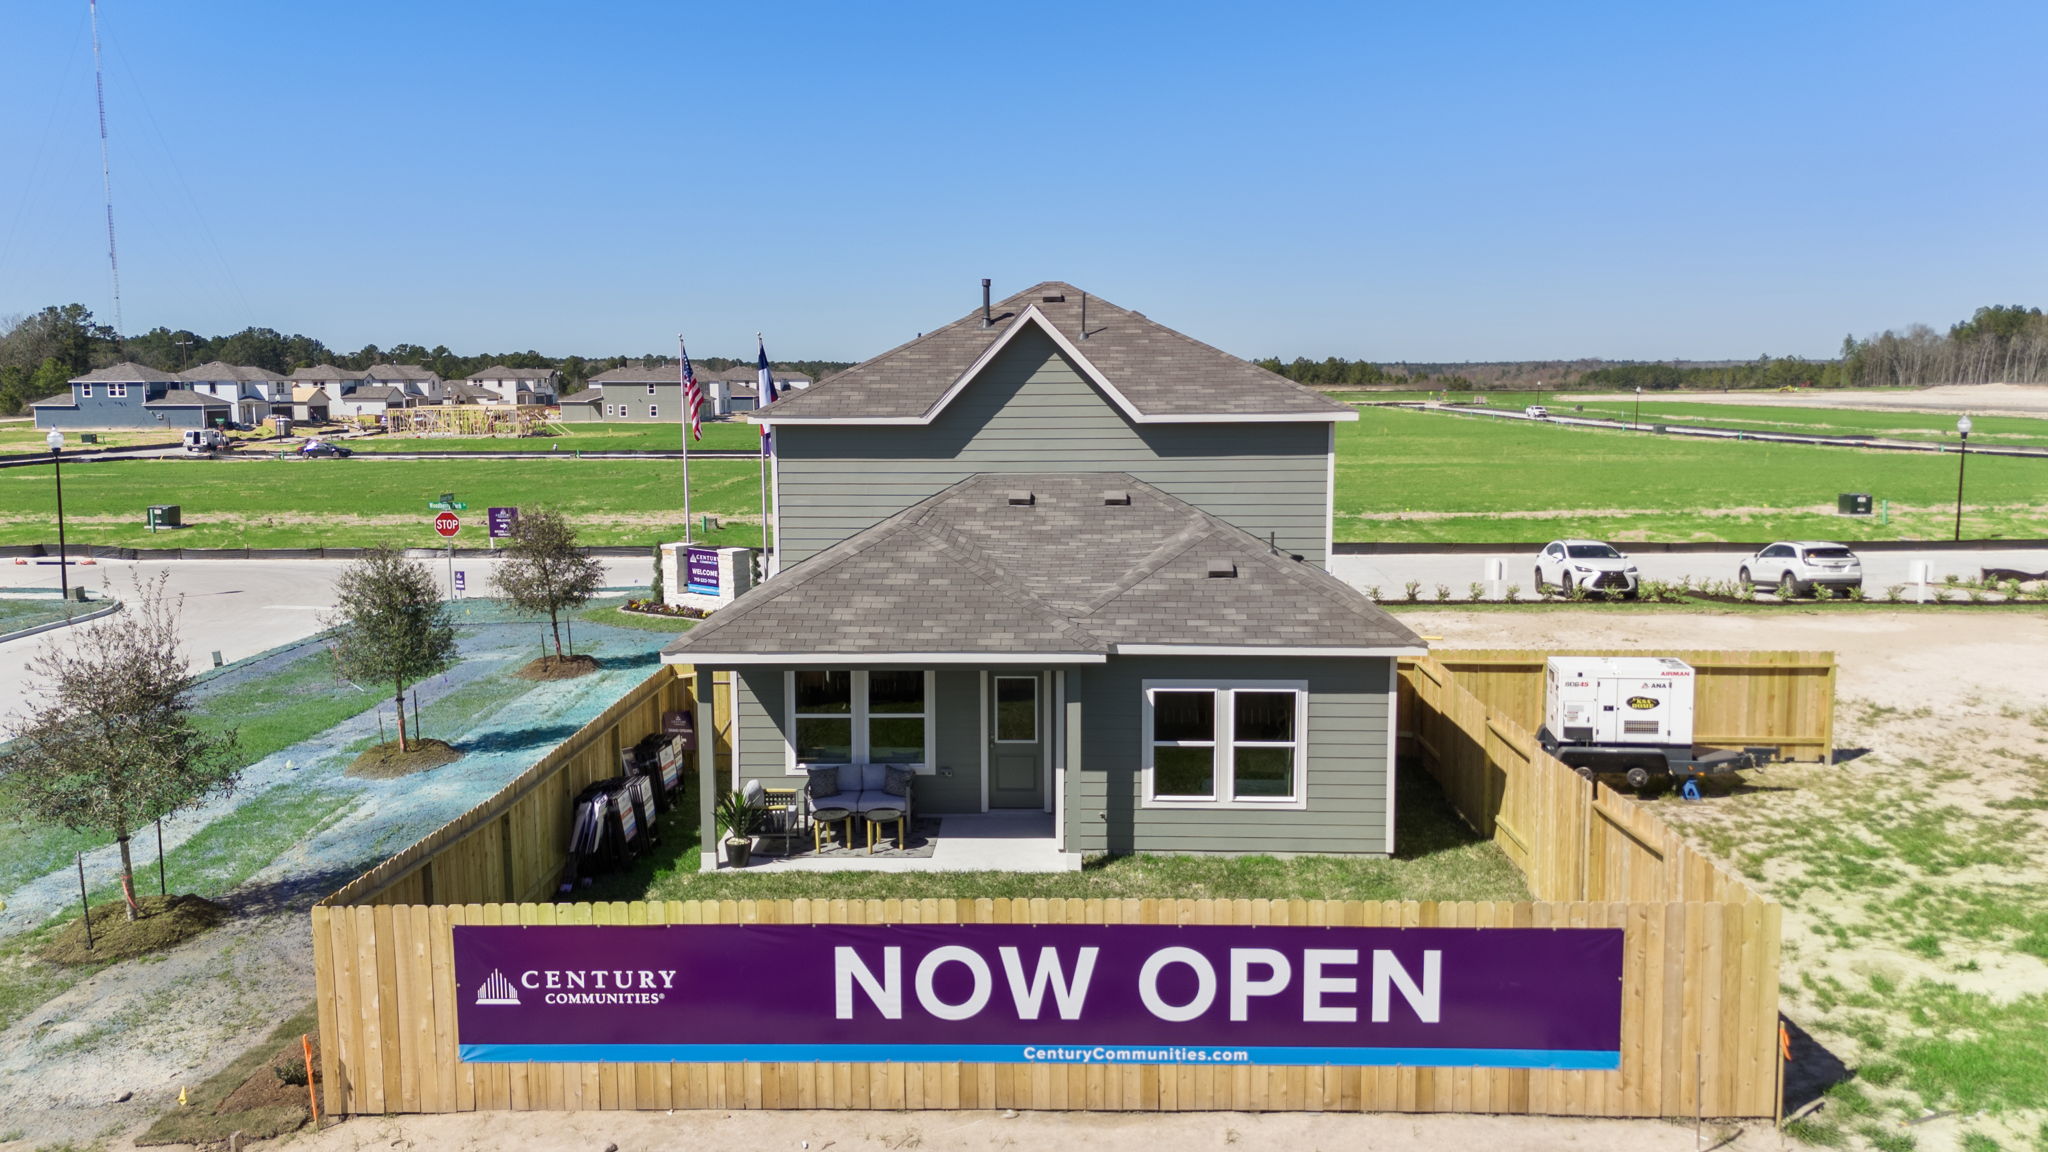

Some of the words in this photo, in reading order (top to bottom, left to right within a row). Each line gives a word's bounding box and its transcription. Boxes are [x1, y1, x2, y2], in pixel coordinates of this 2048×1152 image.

[436, 519, 458, 529] STOP
[692, 568, 718, 577] WELCOME
[521, 970, 676, 989] CENTURY
[834, 945, 1099, 1021] NOW
[1138, 946, 1443, 1023] OPEN
[545, 993, 660, 1005] COMMUNITIES
[1023, 1046, 1249, 1063] CenturyCommunities.com
